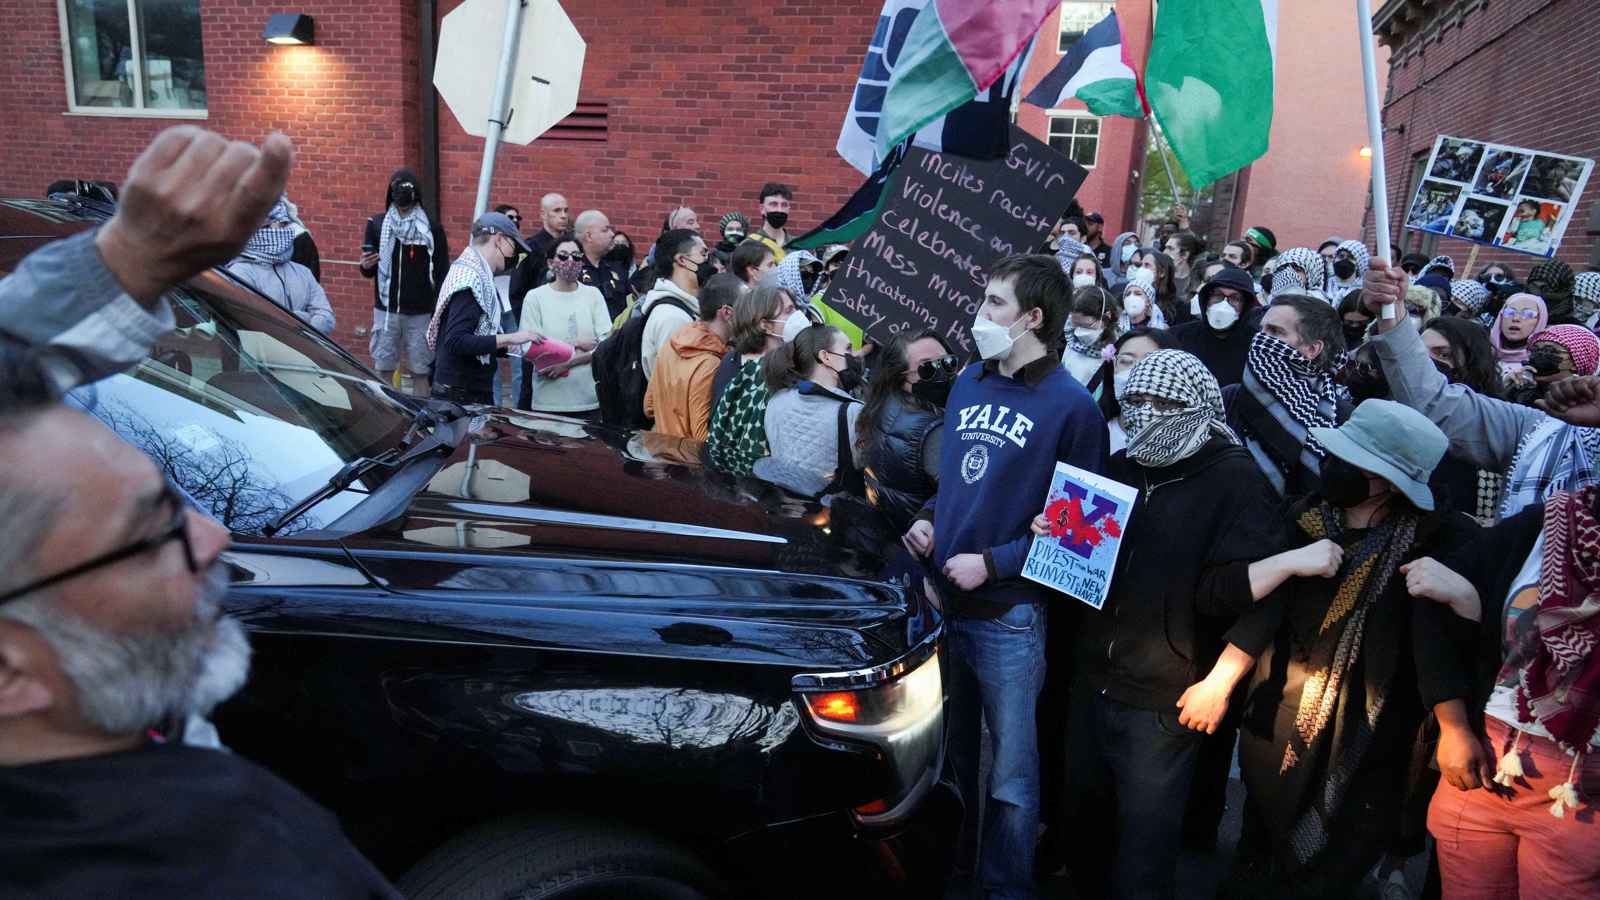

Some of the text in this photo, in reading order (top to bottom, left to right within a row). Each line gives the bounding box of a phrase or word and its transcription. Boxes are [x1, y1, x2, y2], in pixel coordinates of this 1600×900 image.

[903, 175, 985, 243] Violence
[989, 189, 1052, 231] racist
[928, 272, 980, 316] Murd
[955, 404, 1034, 448] YALE
[960, 432, 1007, 448] UNIVERSITY
[1025, 558, 1079, 591] REINVEST
[1081, 577, 1105, 594] NEW
[1033, 540, 1080, 570] DIVEST
[1087, 564, 1106, 582] WAR
[1074, 587, 1103, 606] HAVEN
